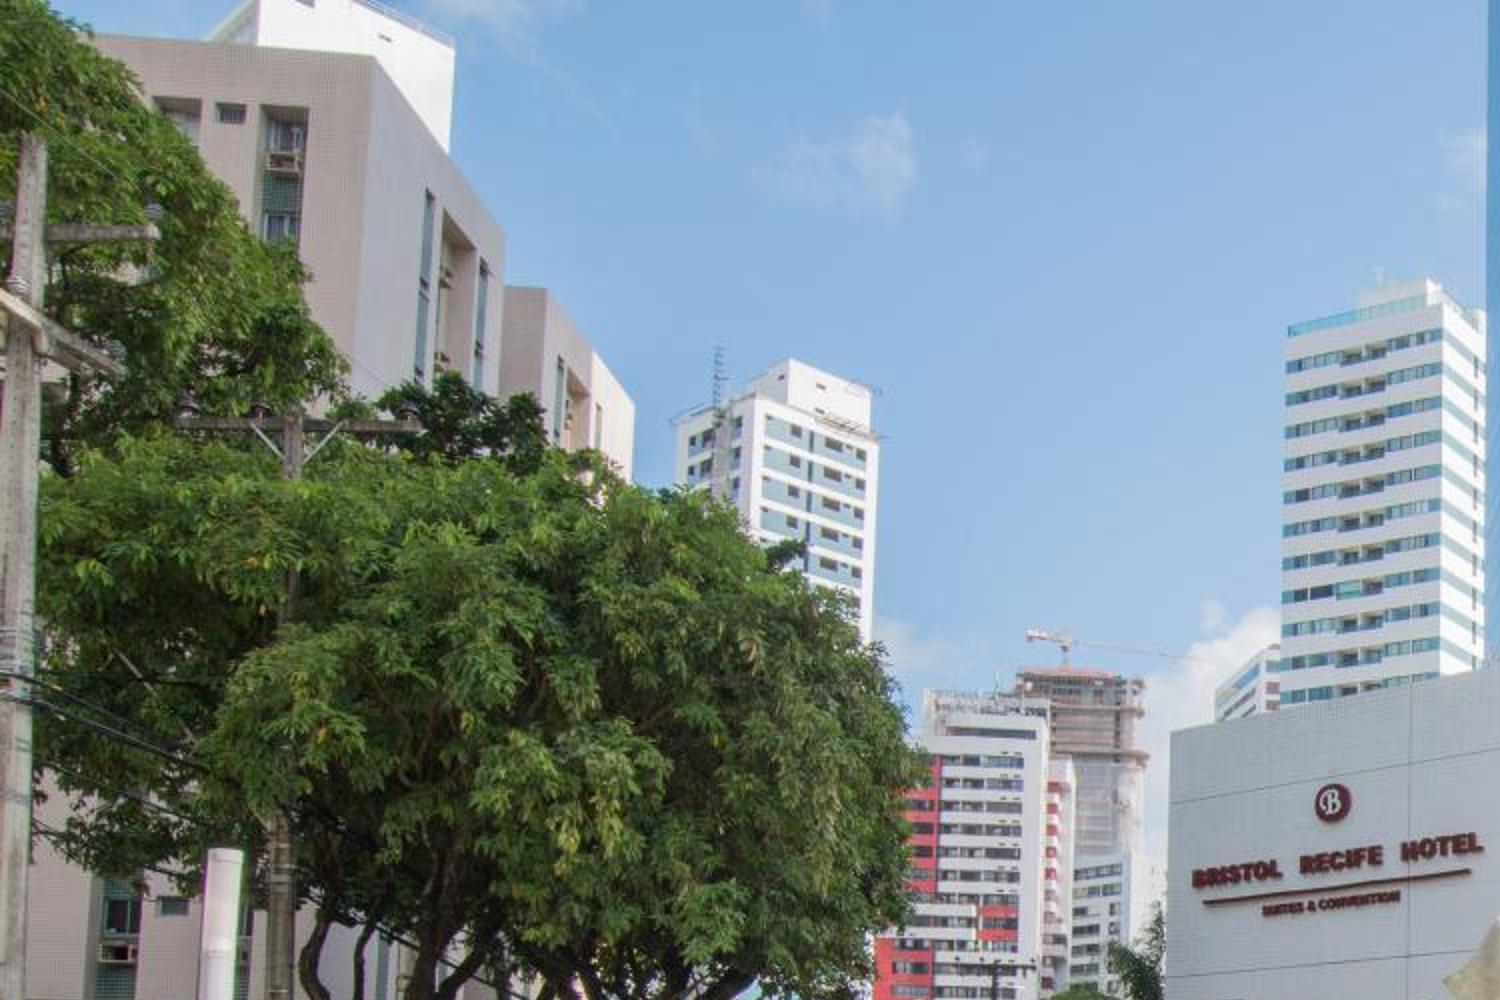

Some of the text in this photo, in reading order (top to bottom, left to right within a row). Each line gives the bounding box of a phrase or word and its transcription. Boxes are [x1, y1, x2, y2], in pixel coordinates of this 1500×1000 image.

[1191, 832, 1485, 889] BRISTOL RECIFE HOTEL
